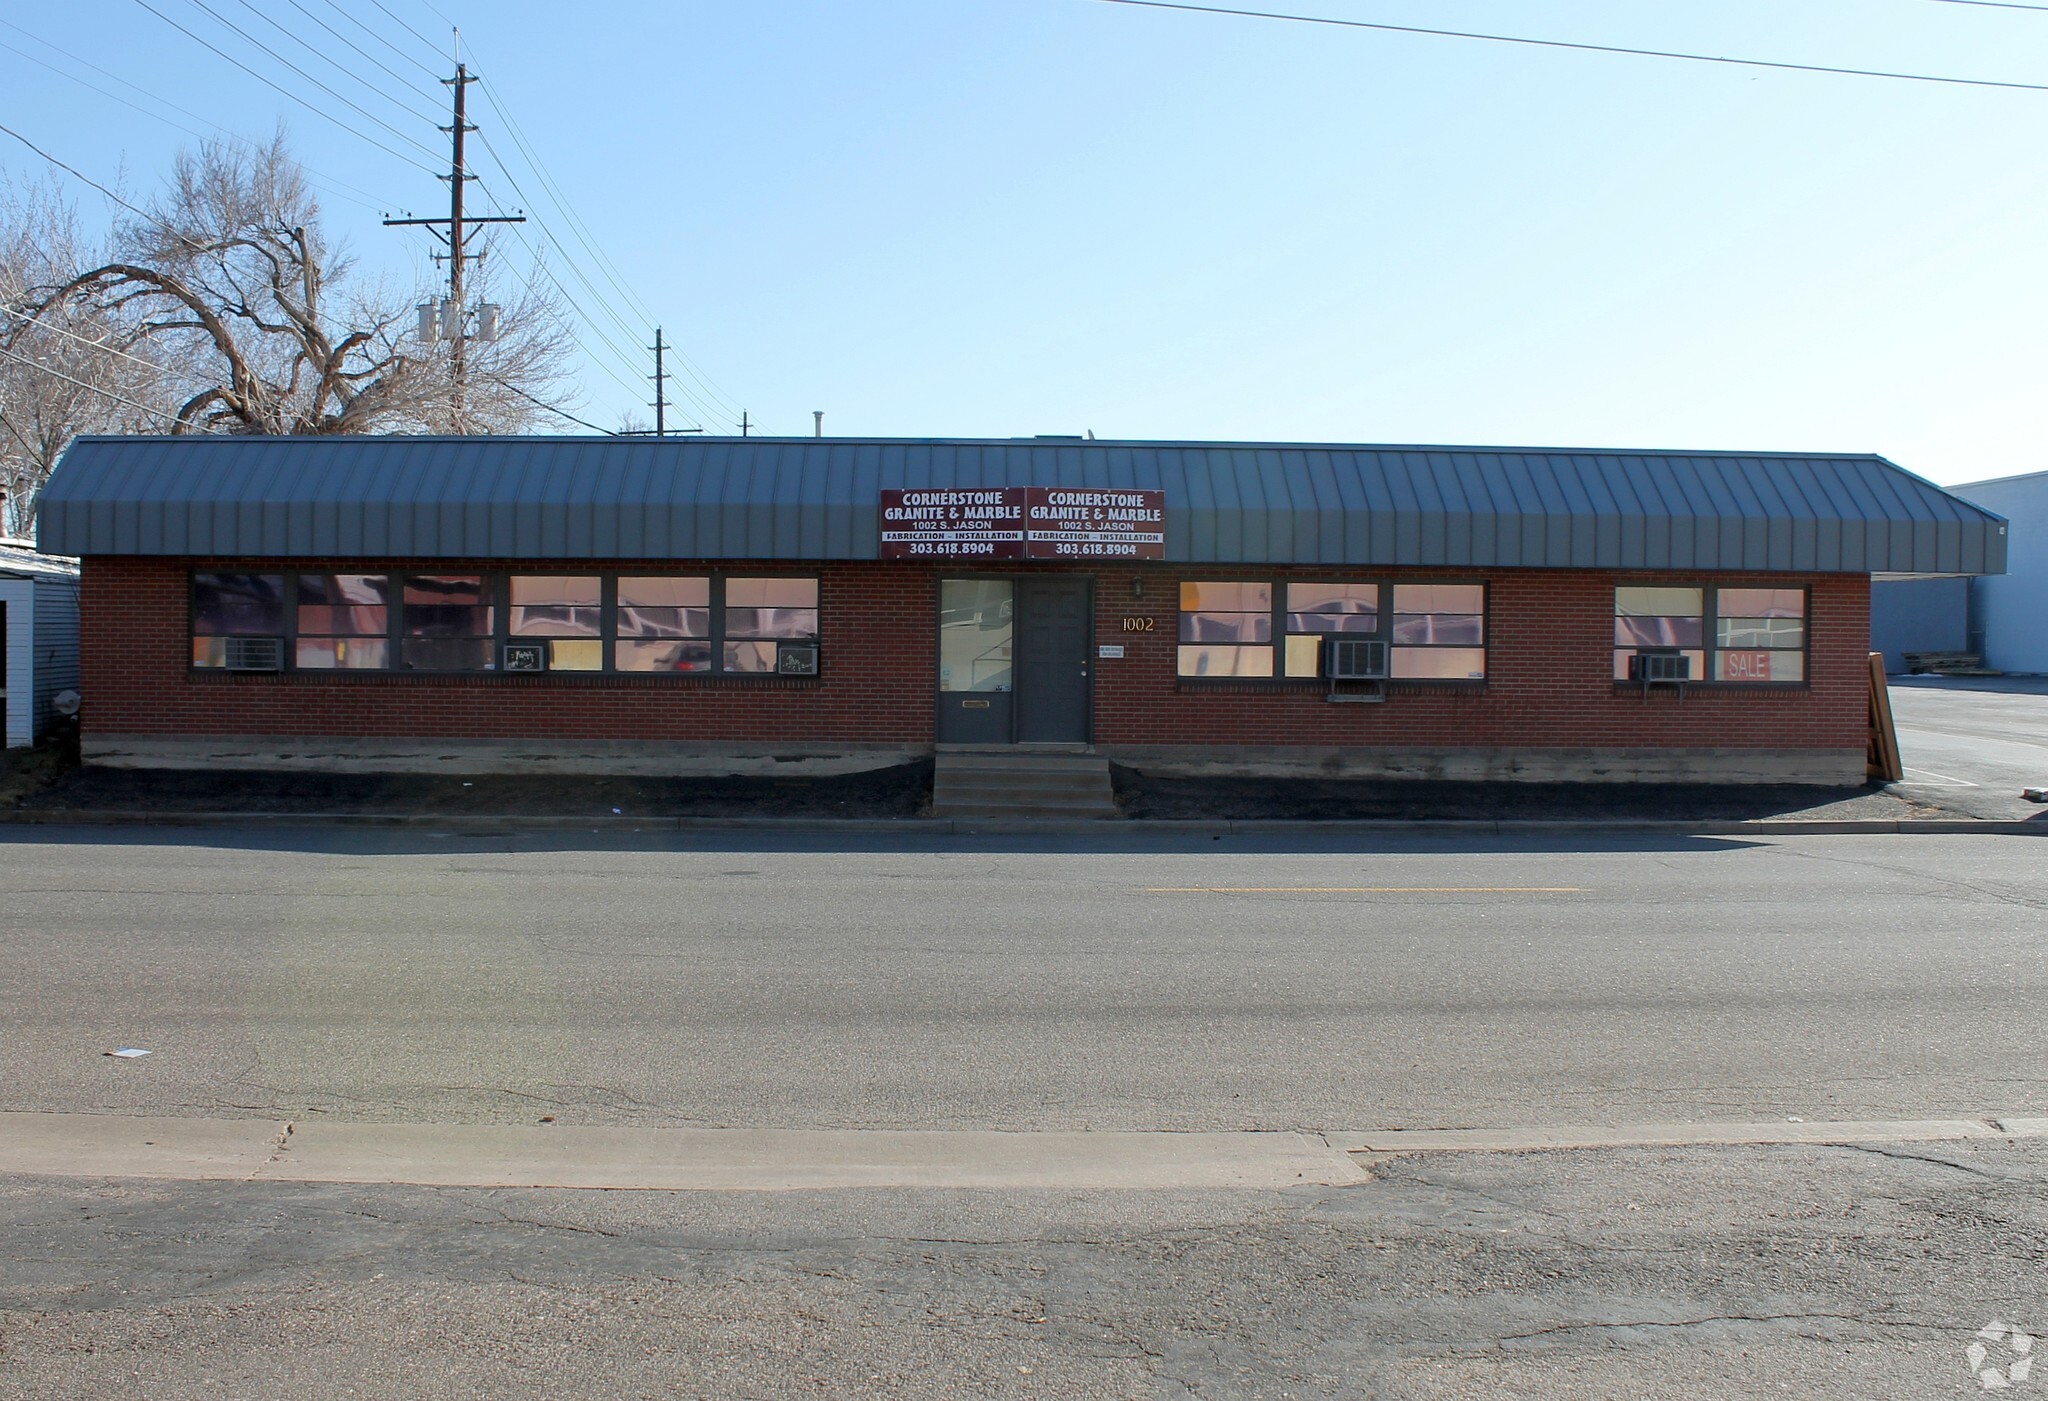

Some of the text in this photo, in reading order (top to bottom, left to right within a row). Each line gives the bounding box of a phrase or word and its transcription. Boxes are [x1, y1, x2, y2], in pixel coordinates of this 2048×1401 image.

[902, 492, 1003, 506] CORNERSTONE
[1048, 492, 1144, 507] CORNERSTONE
[885, 506, 1021, 520] GRANITE & MARBLE
[1030, 506, 1161, 522] GRANITE & MARBLE
[912, 521, 992, 530] 1002 S. JASON
[1058, 521, 1135, 531] 1002 S. JASON
[955, 532, 1018, 540] INSTALLATION
[1032, 532, 1090, 540] FABRICATION
[1100, 533, 1159, 541] INSTALLATION
[909, 543, 994, 554] 303.618.8904
[1056, 543, 1137, 555] 303.618.8904
[1123, 617, 1154, 632] 1002
[1728, 653, 1766, 678] SALE
